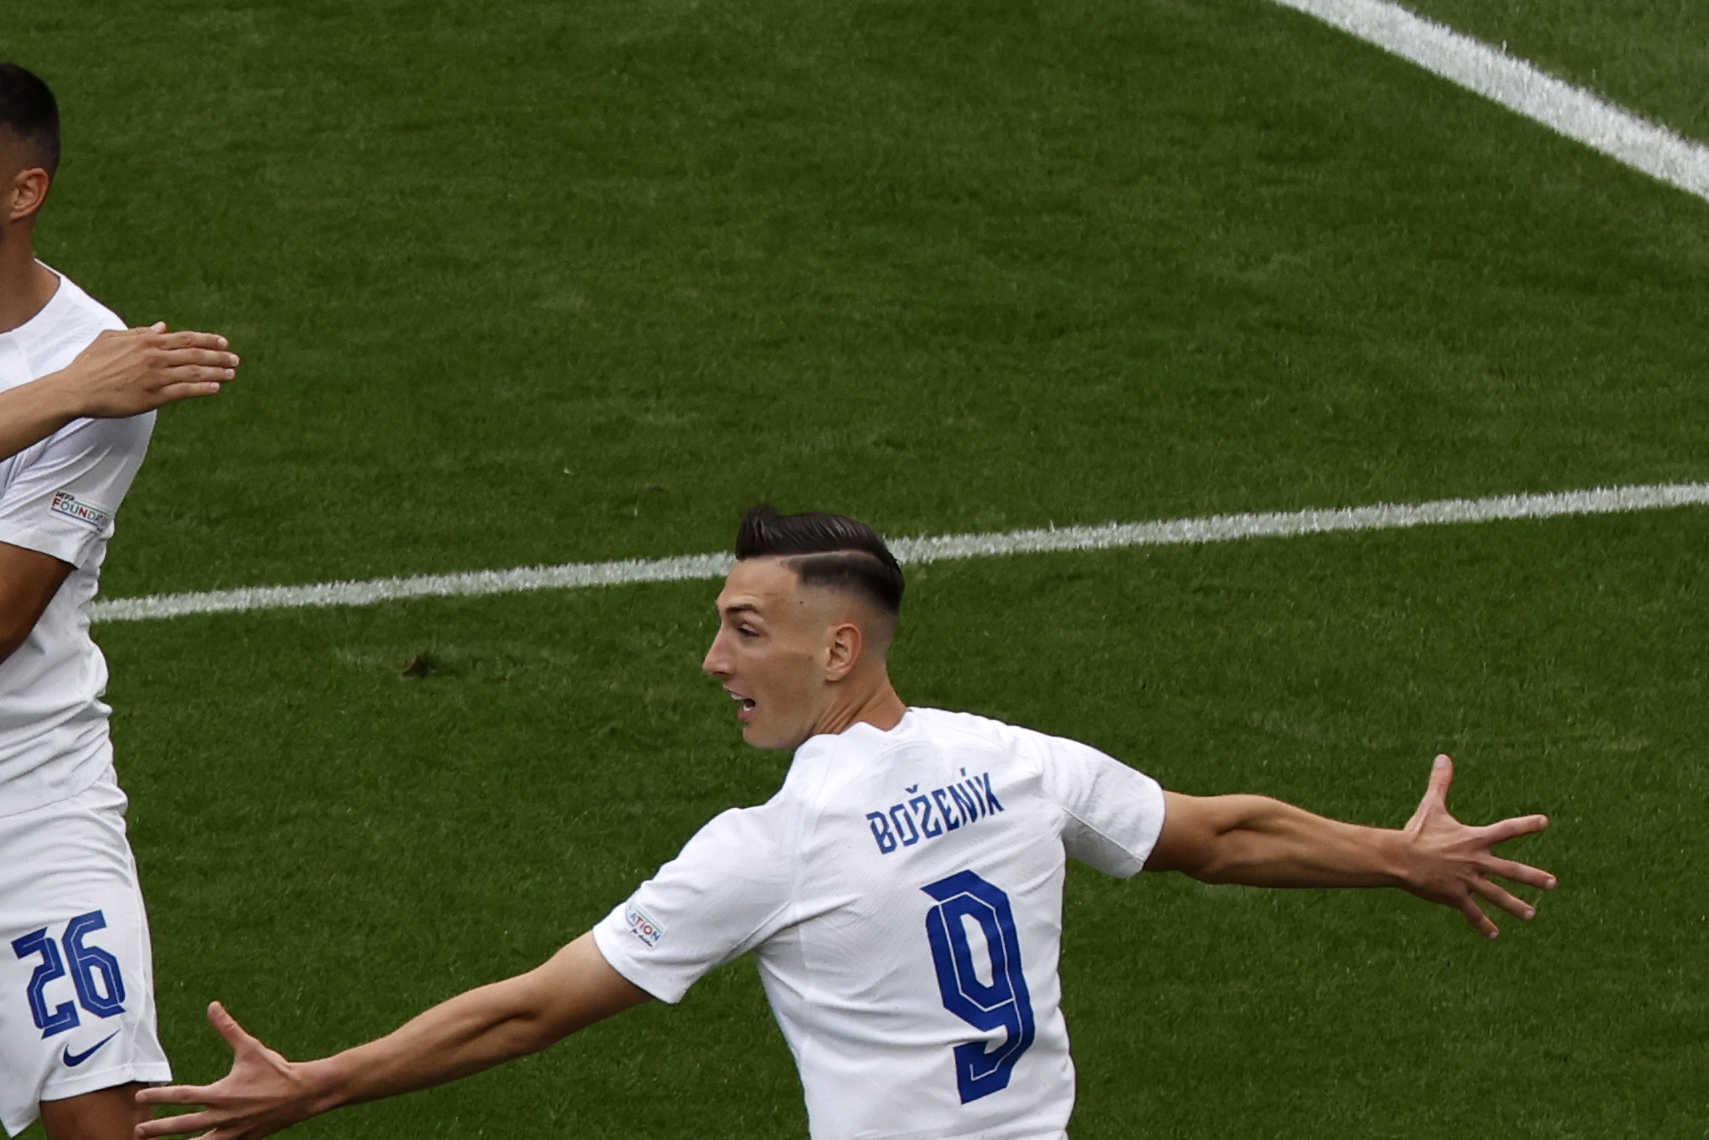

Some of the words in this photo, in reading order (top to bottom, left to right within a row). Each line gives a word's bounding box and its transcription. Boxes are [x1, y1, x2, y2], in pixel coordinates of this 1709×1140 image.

[865, 767, 1004, 855] BOŽENÍK
[11, 909, 127, 1040] 26
[920, 869, 1036, 1105] 9
